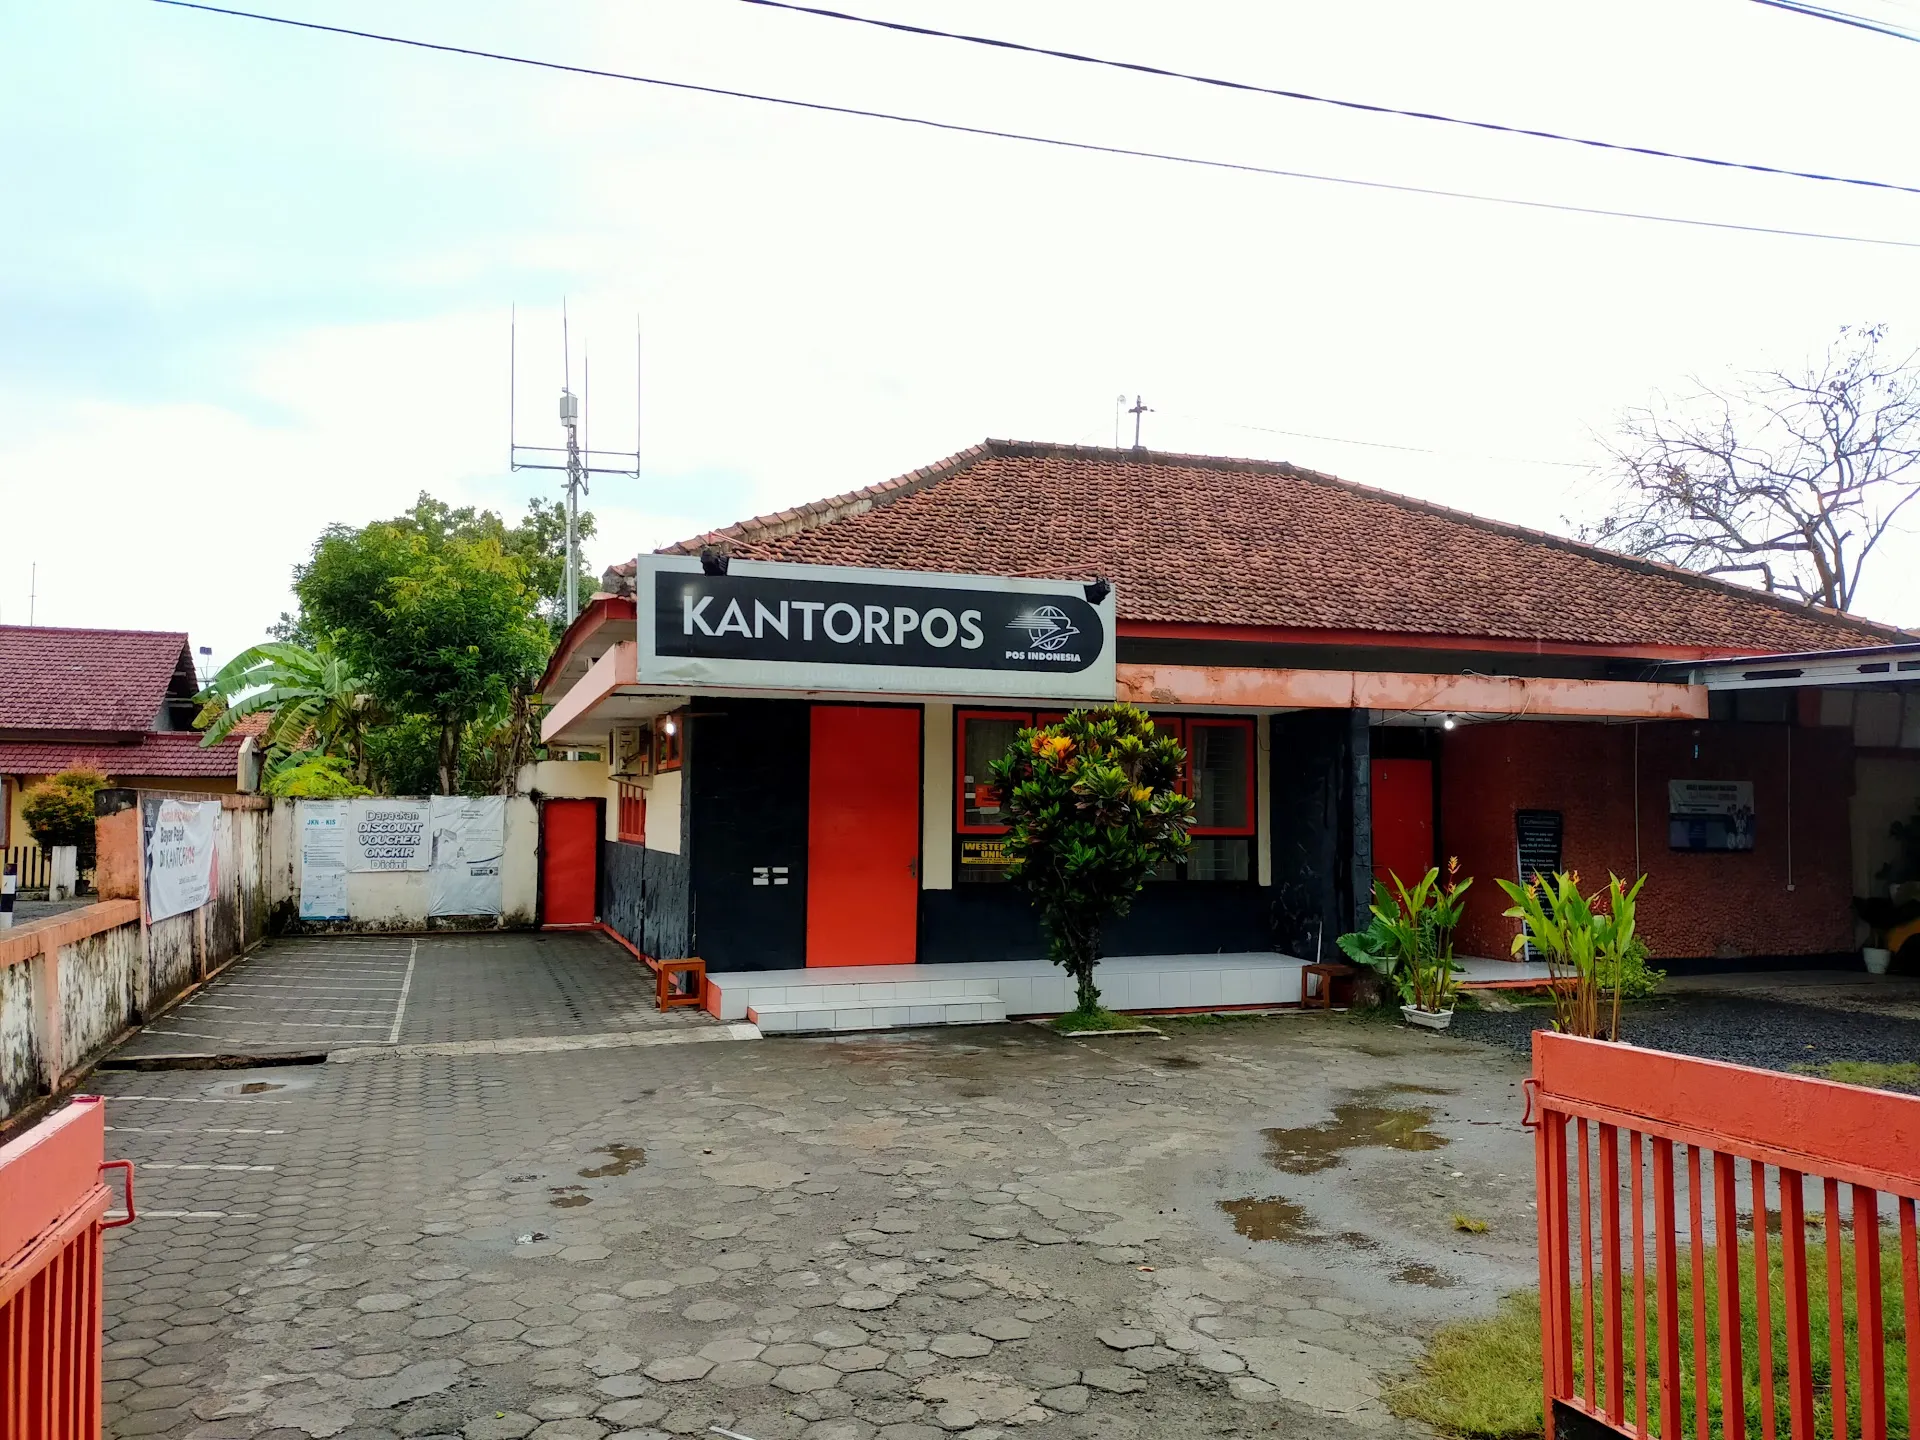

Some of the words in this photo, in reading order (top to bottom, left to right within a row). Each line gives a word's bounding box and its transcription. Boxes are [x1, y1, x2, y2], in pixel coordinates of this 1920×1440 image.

[683, 596, 984, 649] KANTORPOS
[1005, 651, 1025, 660] POS
[1028, 652, 1081, 662] INDONESIA
[366, 810, 420, 822] Dapatkan
[358, 822, 424, 833] DISCOUNT
[358, 834, 421, 845] VOUCHER
[364, 847, 415, 858] ONGKIR
